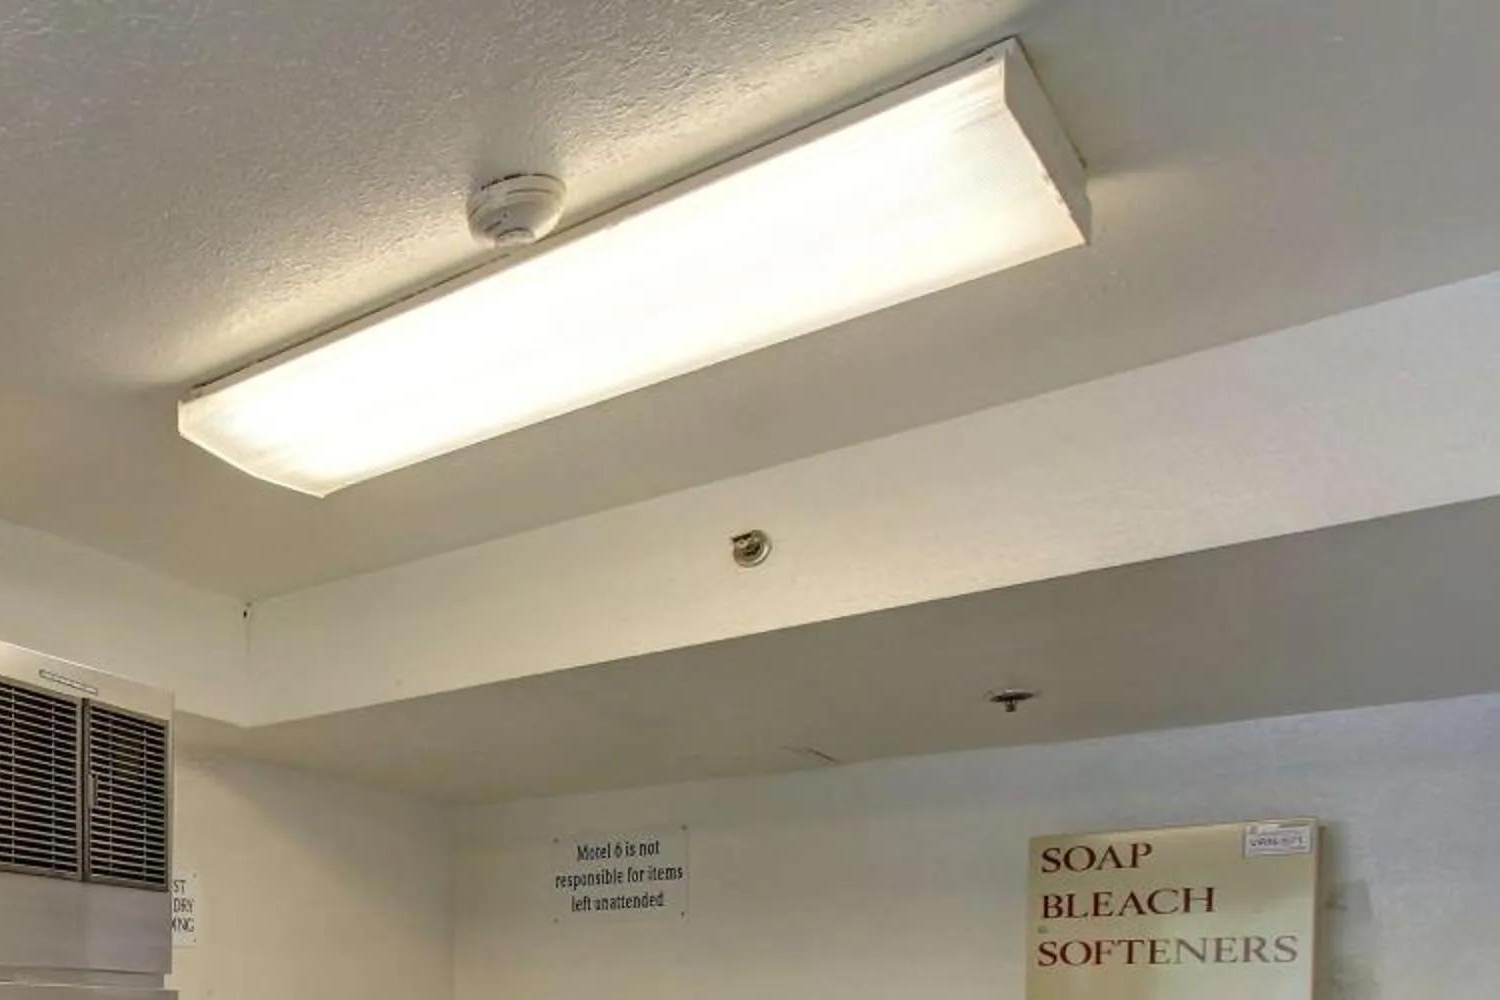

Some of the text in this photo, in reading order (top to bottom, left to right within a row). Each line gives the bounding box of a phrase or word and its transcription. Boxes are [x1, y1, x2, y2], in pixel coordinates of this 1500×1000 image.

[576, 840, 659, 861] Motel 6 is not
[1041, 842, 1153, 873] SOAP
[555, 865, 683, 890] responsible for items
[571, 891, 664, 912] left unattended
[1041, 887, 1216, 920] BLEACH
[1037, 935, 1299, 967] SOFTENERS
